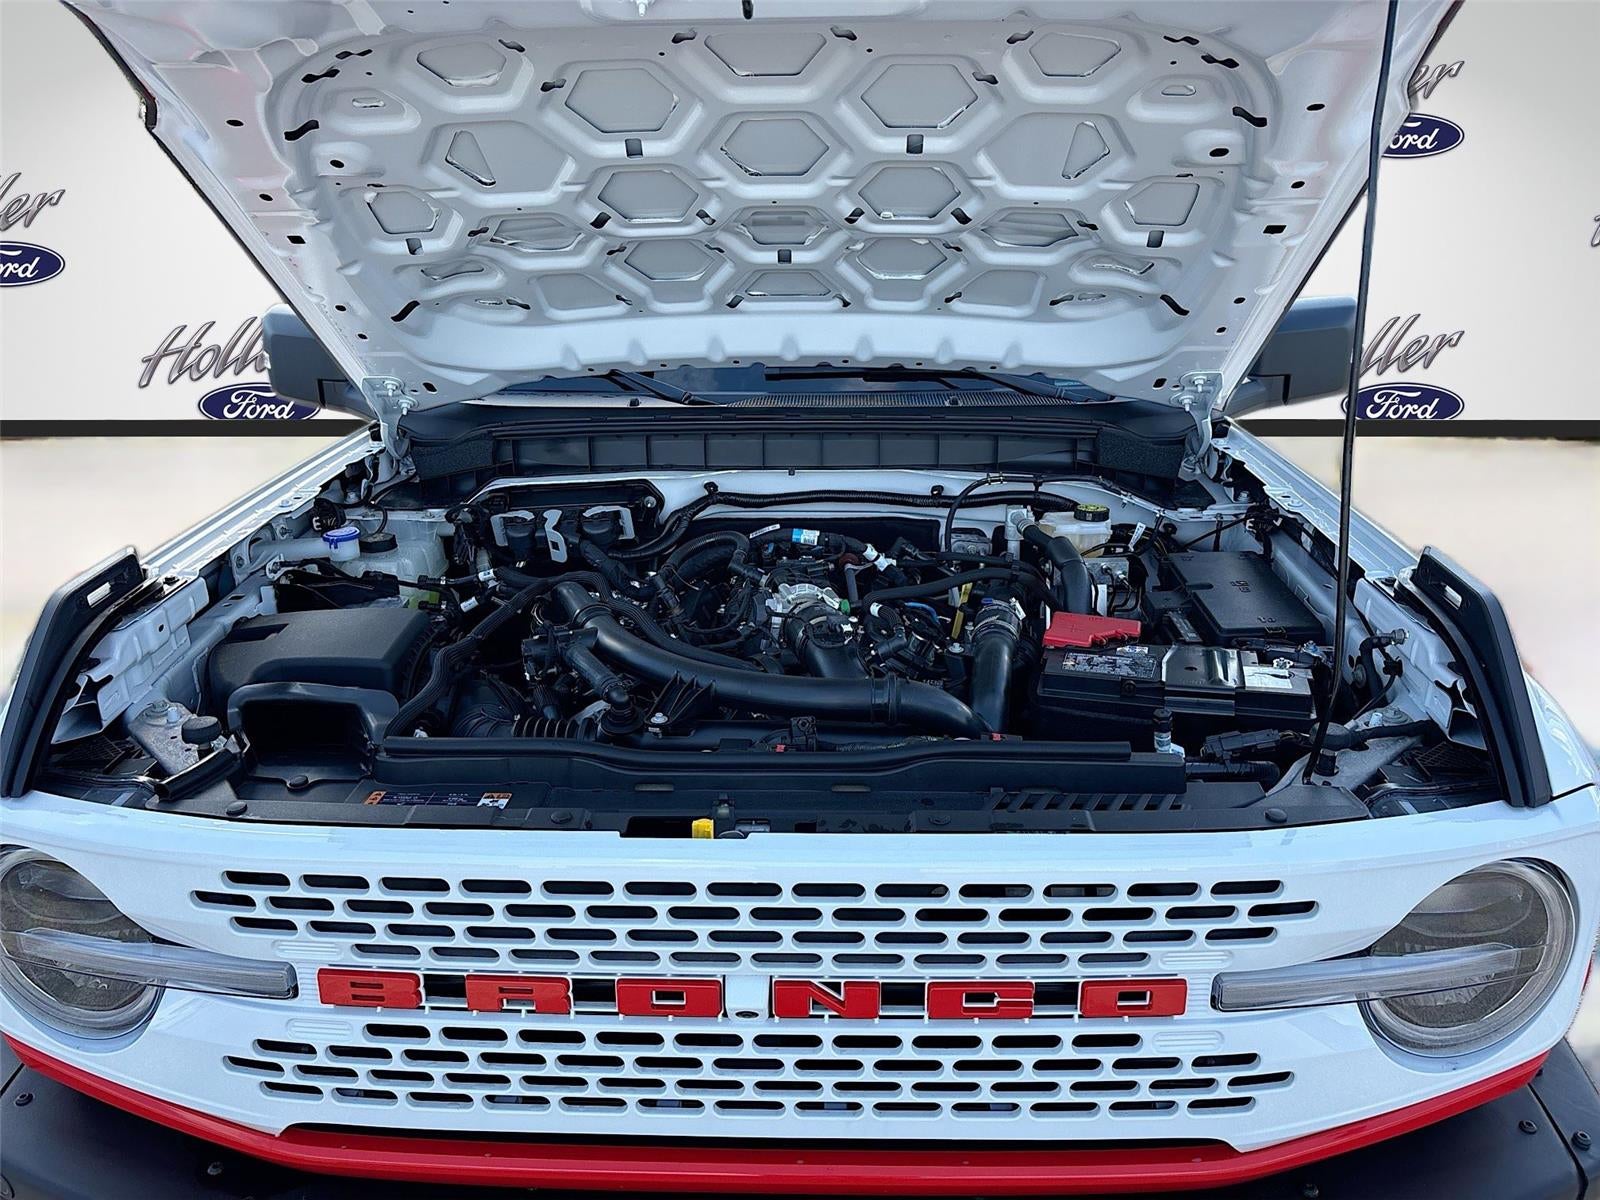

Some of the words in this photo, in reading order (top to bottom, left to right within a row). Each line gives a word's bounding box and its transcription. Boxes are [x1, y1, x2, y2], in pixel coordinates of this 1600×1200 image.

[1389, 121, 1440, 149] ord
[138, 316, 268, 388] Holl
[223, 390, 295, 419] Ford
[1365, 389, 1440, 419] Ford
[316, 967, 1188, 1018] BRONCO
